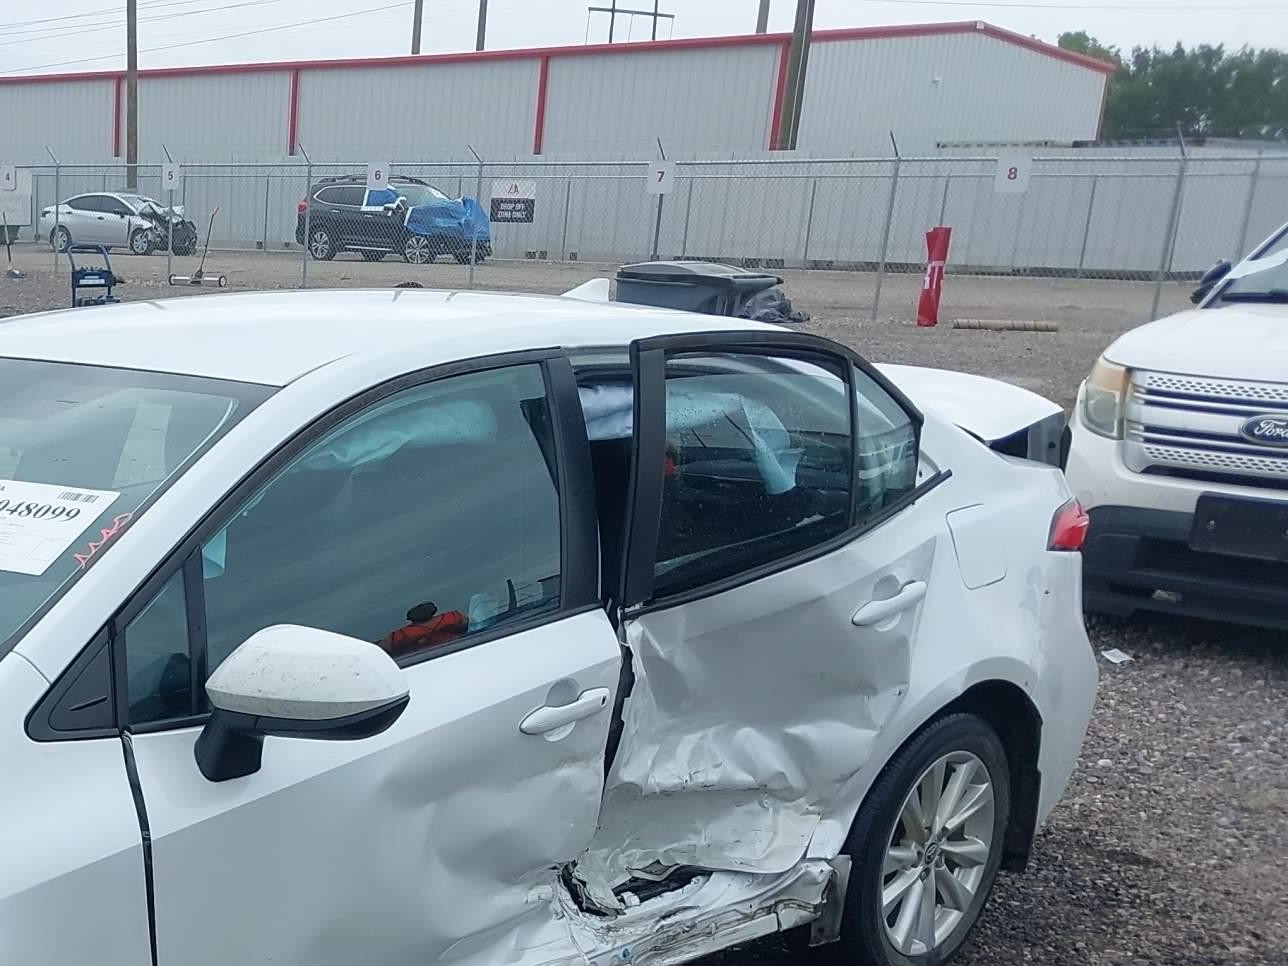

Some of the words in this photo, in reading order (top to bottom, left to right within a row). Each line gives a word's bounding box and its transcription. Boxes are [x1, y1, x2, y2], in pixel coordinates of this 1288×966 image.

[5, 172, 10, 181] 4
[167, 170, 174, 181] 5
[374, 170, 382, 181] 6
[657, 171, 665, 183] 7
[1007, 166, 1018, 180] 8
